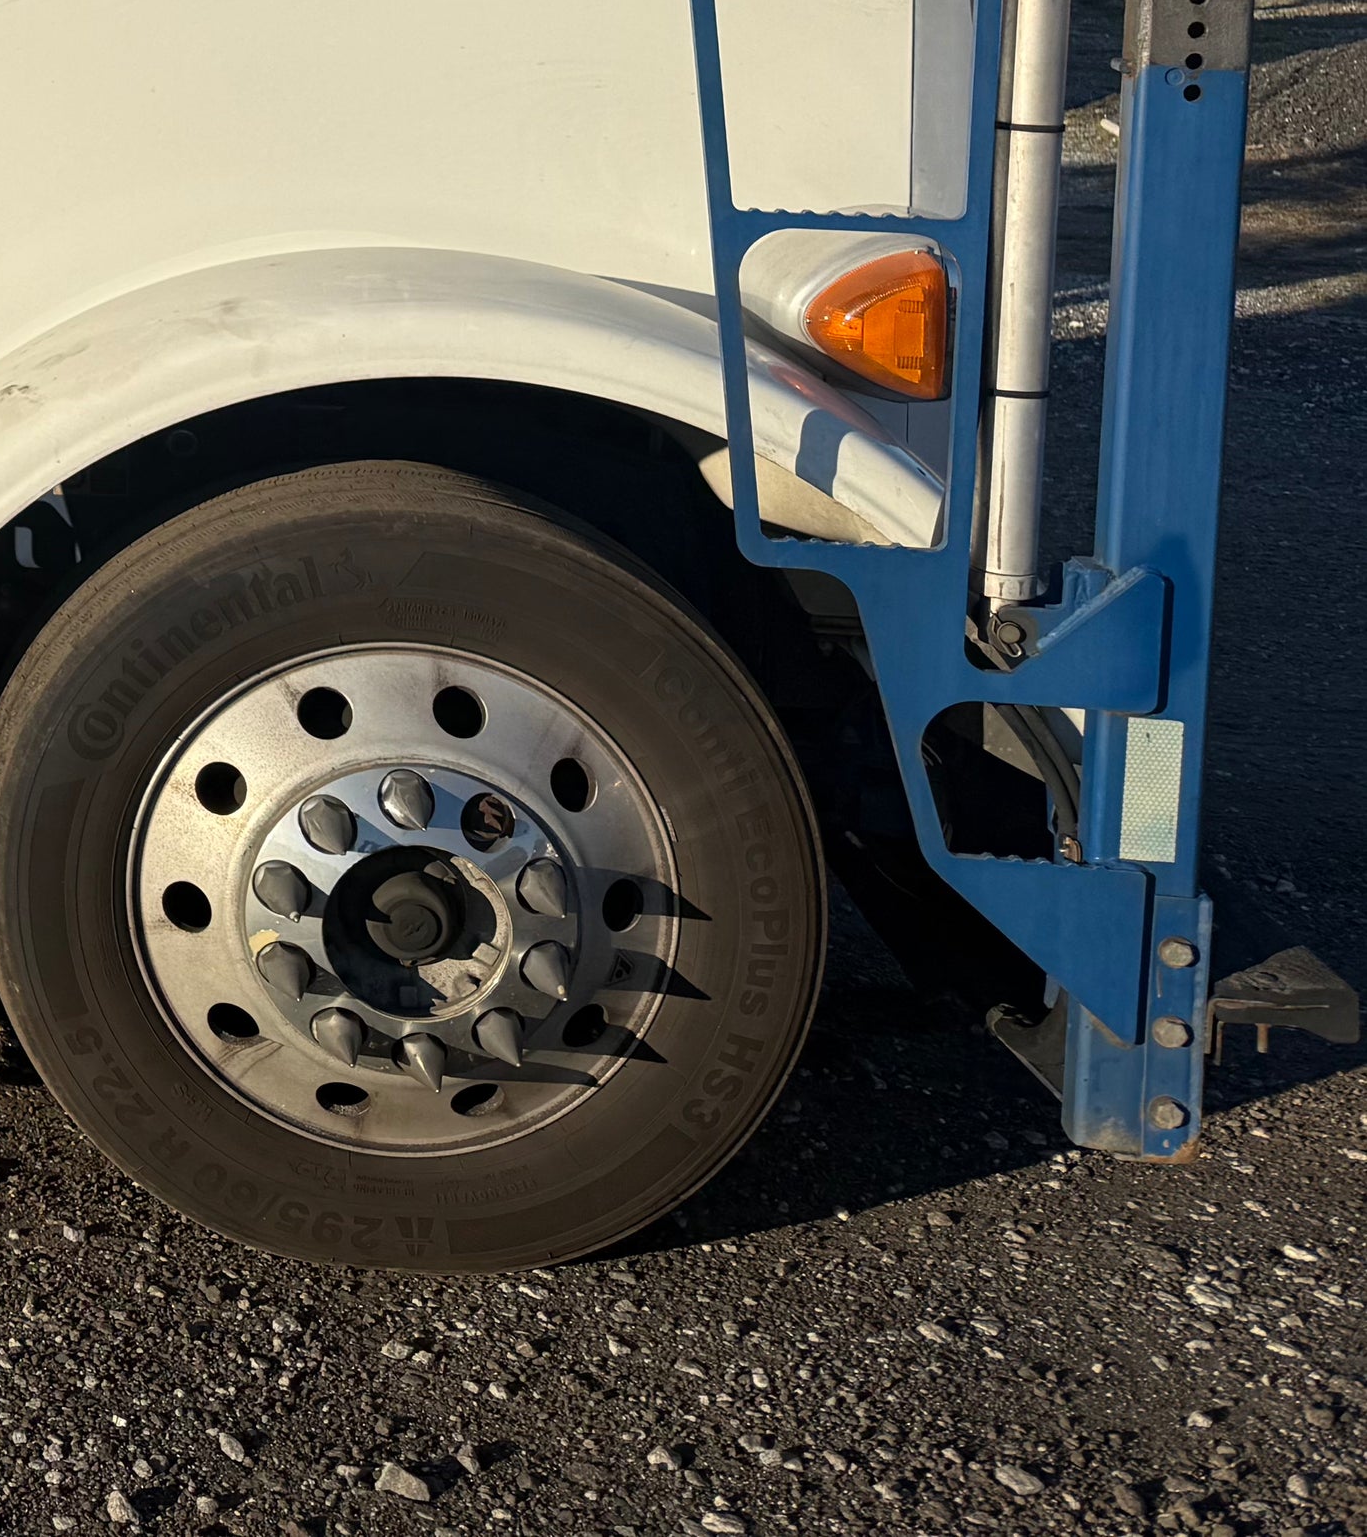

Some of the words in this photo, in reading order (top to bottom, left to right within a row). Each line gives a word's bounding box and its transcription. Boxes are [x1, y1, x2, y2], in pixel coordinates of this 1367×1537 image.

[68, 555, 327, 760] Continental
[735, 806, 793, 1018] EcoPlus
[682, 1032, 765, 1132] HS3
[192, 1163, 385, 1255] 295/60
